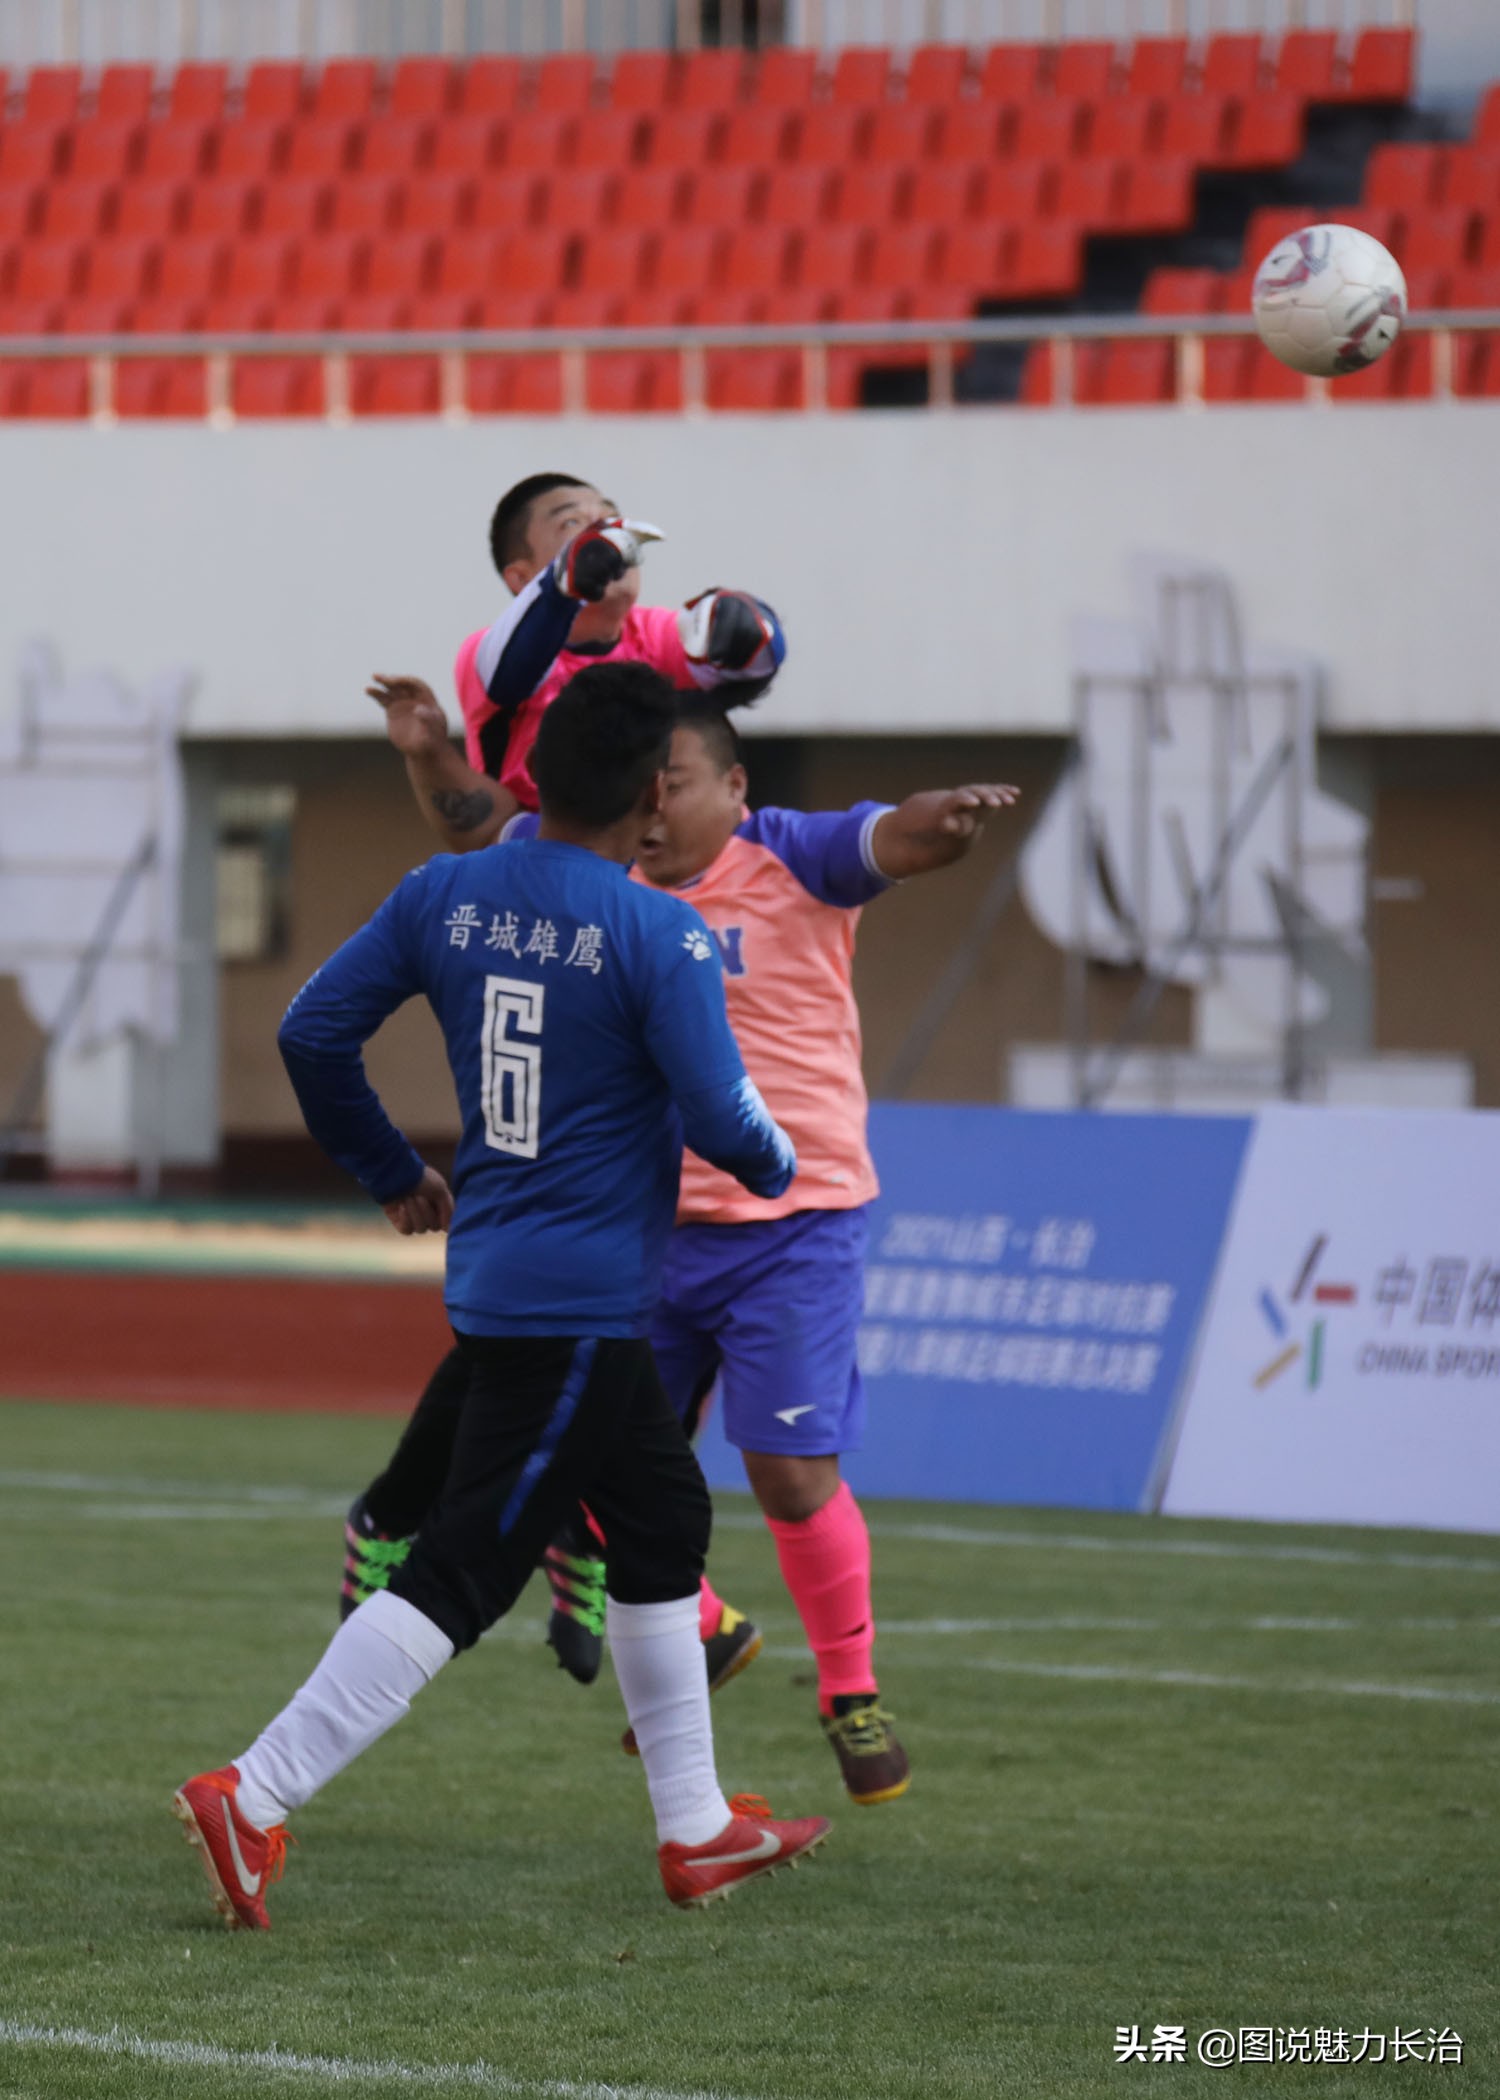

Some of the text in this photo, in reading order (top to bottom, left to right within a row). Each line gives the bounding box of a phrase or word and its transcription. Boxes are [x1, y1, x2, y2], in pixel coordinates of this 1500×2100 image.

[444, 904, 603, 975] 晋城雄鹰
[481, 974, 544, 1160] 6
[1358, 1342, 1429, 1376] CHINA
